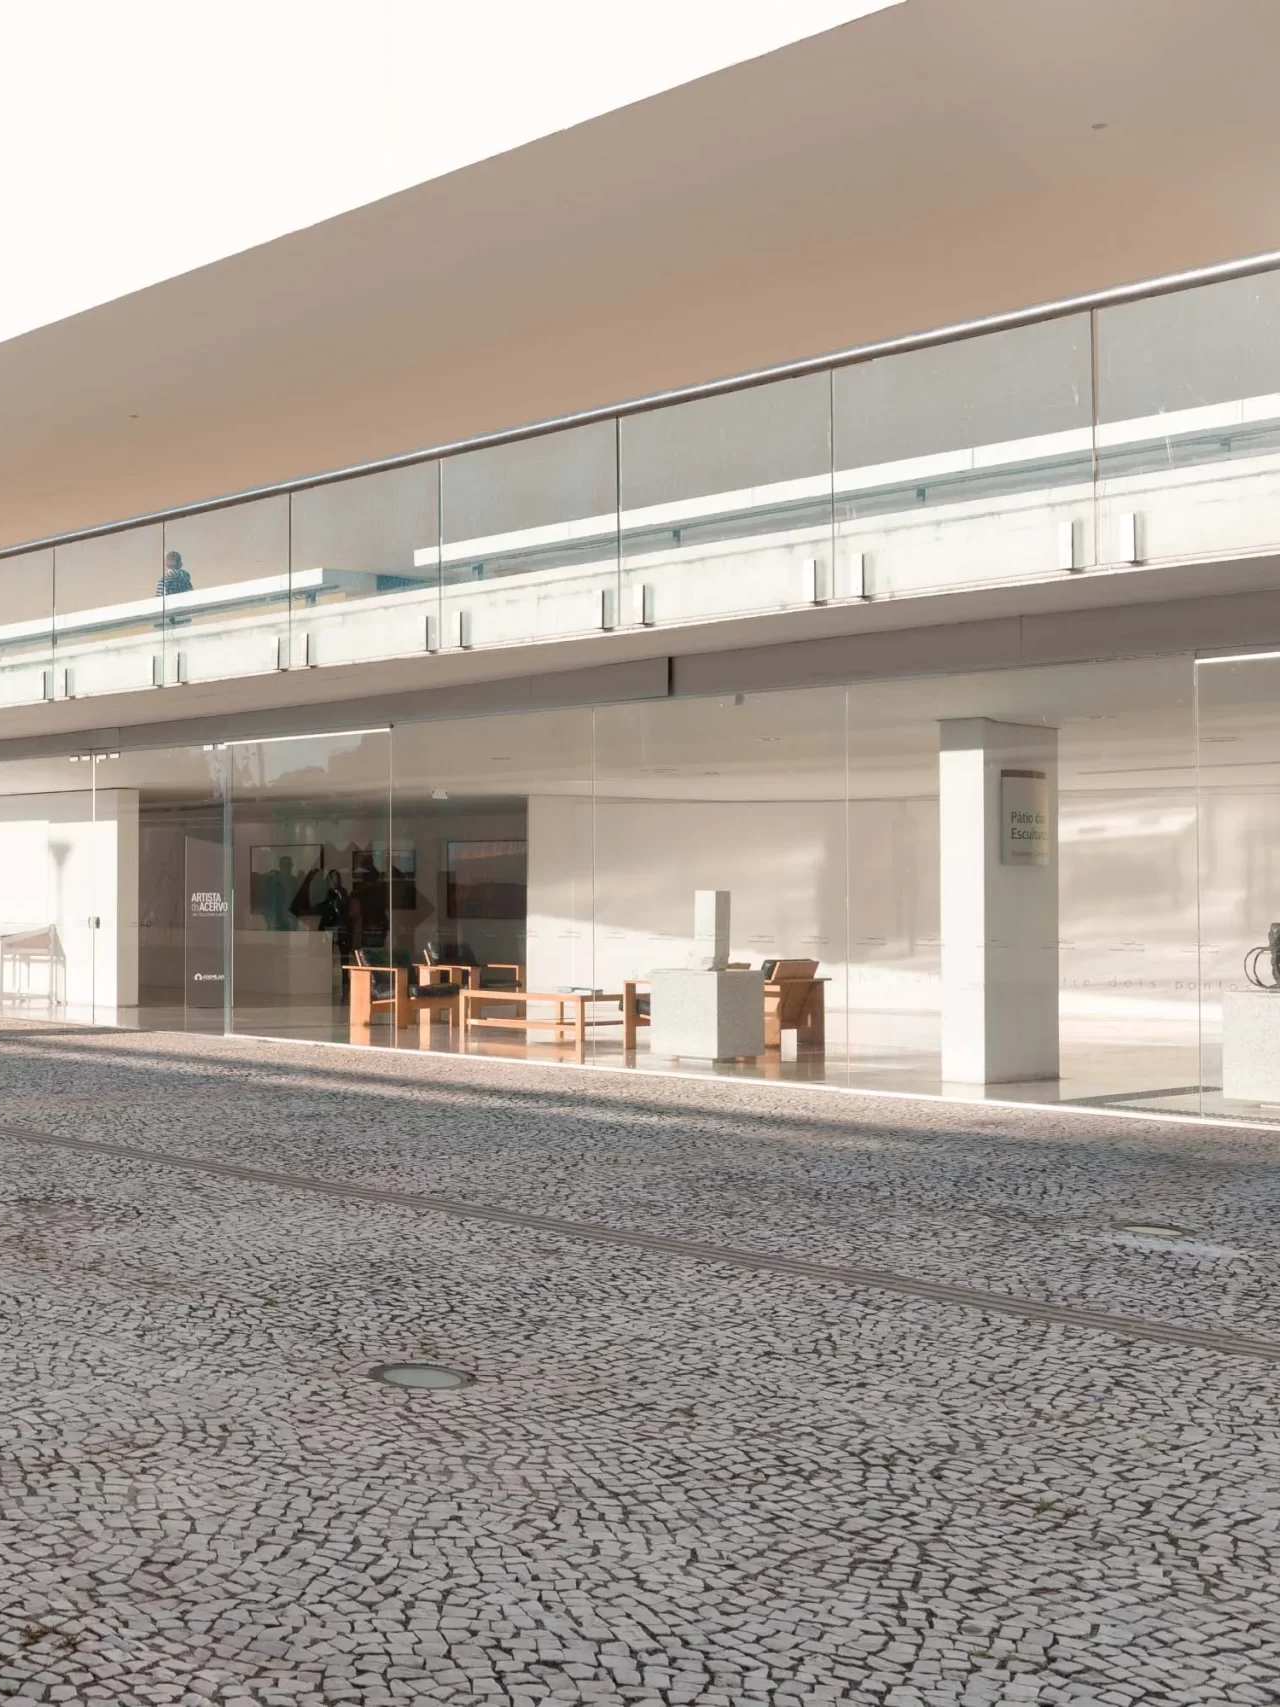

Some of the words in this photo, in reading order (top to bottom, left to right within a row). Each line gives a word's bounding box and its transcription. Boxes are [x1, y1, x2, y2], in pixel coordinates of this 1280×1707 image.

[1011, 811, 1033, 824] Pátio
[191, 892, 222, 902] ARTISTA
[199, 902, 228, 912] ACERVO
